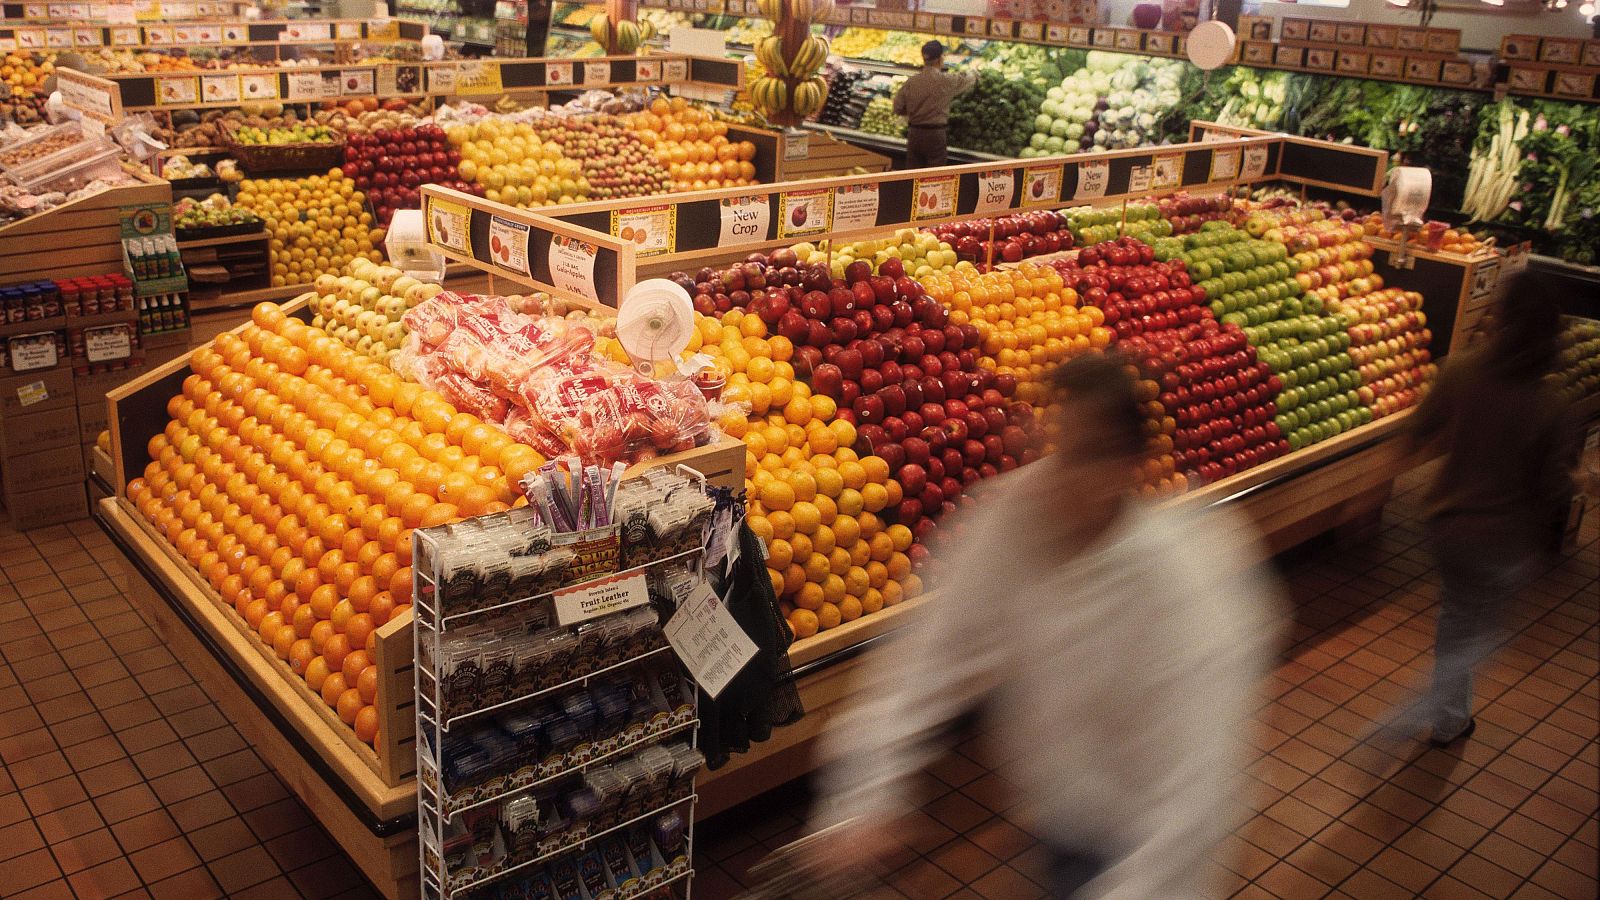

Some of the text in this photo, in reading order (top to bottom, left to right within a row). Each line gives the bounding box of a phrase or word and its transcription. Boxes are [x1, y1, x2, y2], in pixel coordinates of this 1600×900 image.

[1085, 171, 1103, 181] New
[987, 182, 1007, 192] New
[1083, 181, 1101, 192] Crop
[986, 193, 1005, 204] Crop
[733, 209, 759, 222] New
[732, 223, 758, 235] Crop
[580, 591, 630, 609] Fruit Leather
